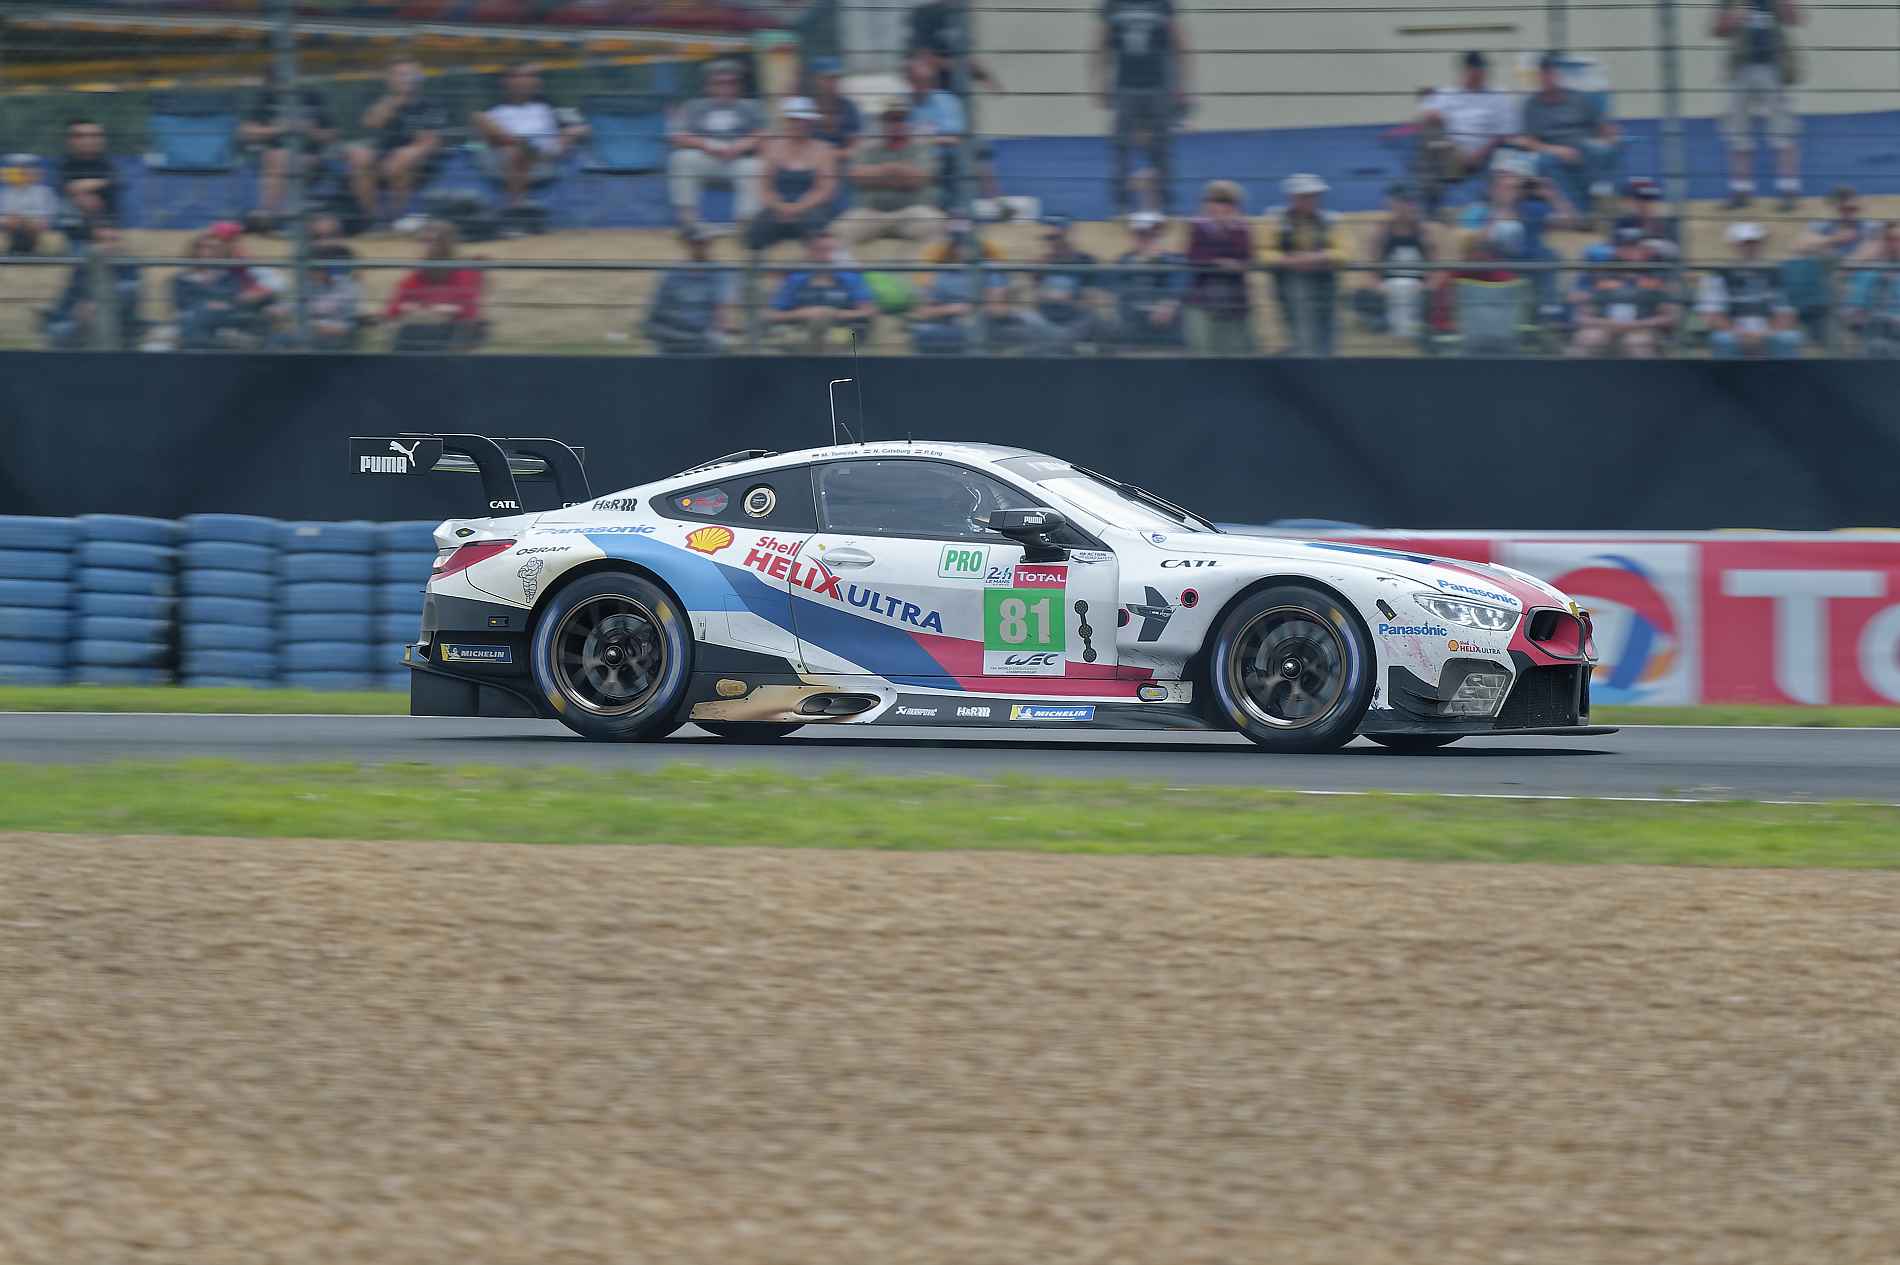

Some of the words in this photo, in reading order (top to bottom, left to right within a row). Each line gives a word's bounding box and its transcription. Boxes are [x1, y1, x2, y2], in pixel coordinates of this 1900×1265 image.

[360, 455, 407, 473] PUMA
[489, 500, 519, 509] CATL
[536, 524, 657, 535] Panasonic
[516, 546, 572, 556] OSRAM
[755, 535, 802, 557] Shell
[944, 549, 983, 573] PRO
[1160, 559, 1224, 568] CATL
[1016, 571, 1066, 583] TOTAL
[743, 547, 844, 602] HELIX
[847, 584, 943, 634] ULTRA
[1437, 580, 1518, 606] Panasonic
[999, 597, 1051, 644] 81
[1378, 623, 1448, 637] Panasonic
[460, 650, 505, 658] MICHELIN
[1481, 647, 1501, 655] ULTRA
[1004, 652, 1059, 666] WEC
[1034, 709, 1087, 717] MICHELIN
